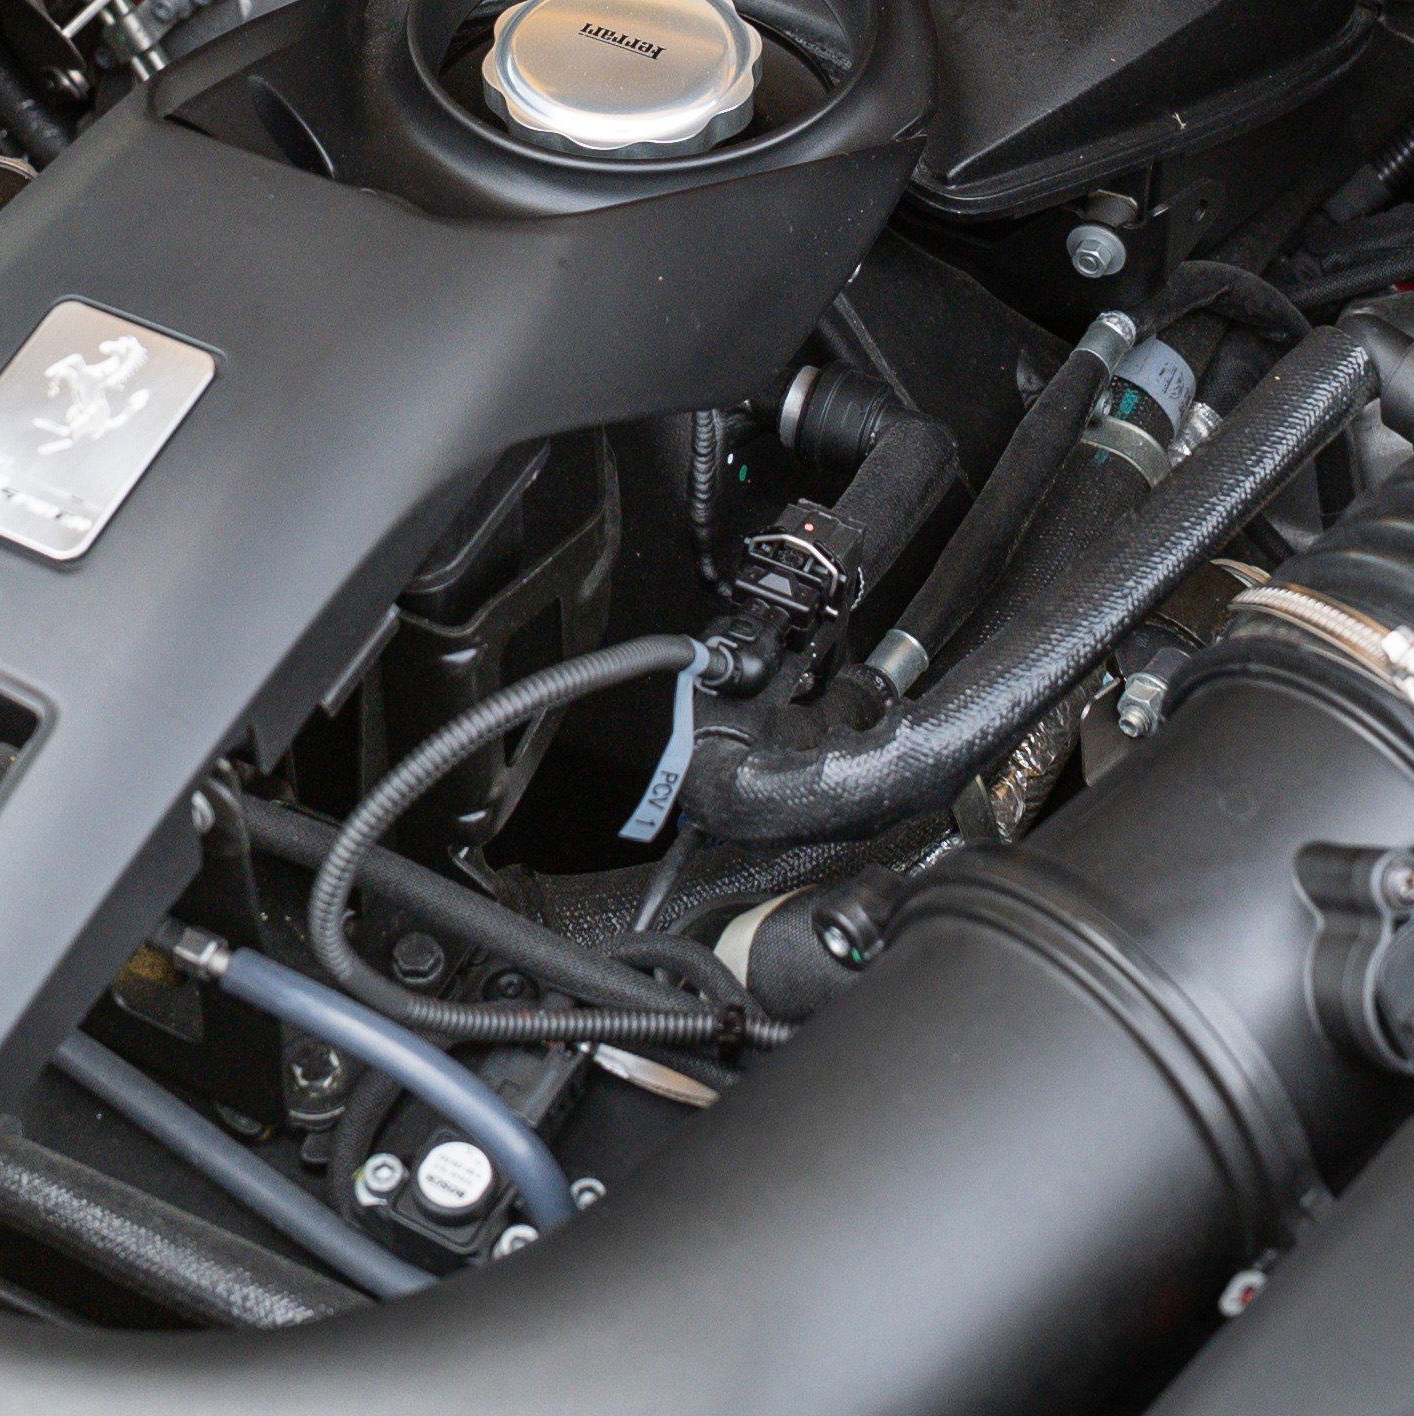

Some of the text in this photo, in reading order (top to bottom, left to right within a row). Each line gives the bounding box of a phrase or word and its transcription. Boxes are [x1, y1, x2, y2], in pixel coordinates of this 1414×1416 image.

[578, 22, 666, 60] Ferrari
[635, 770, 679, 826] PCV 1
